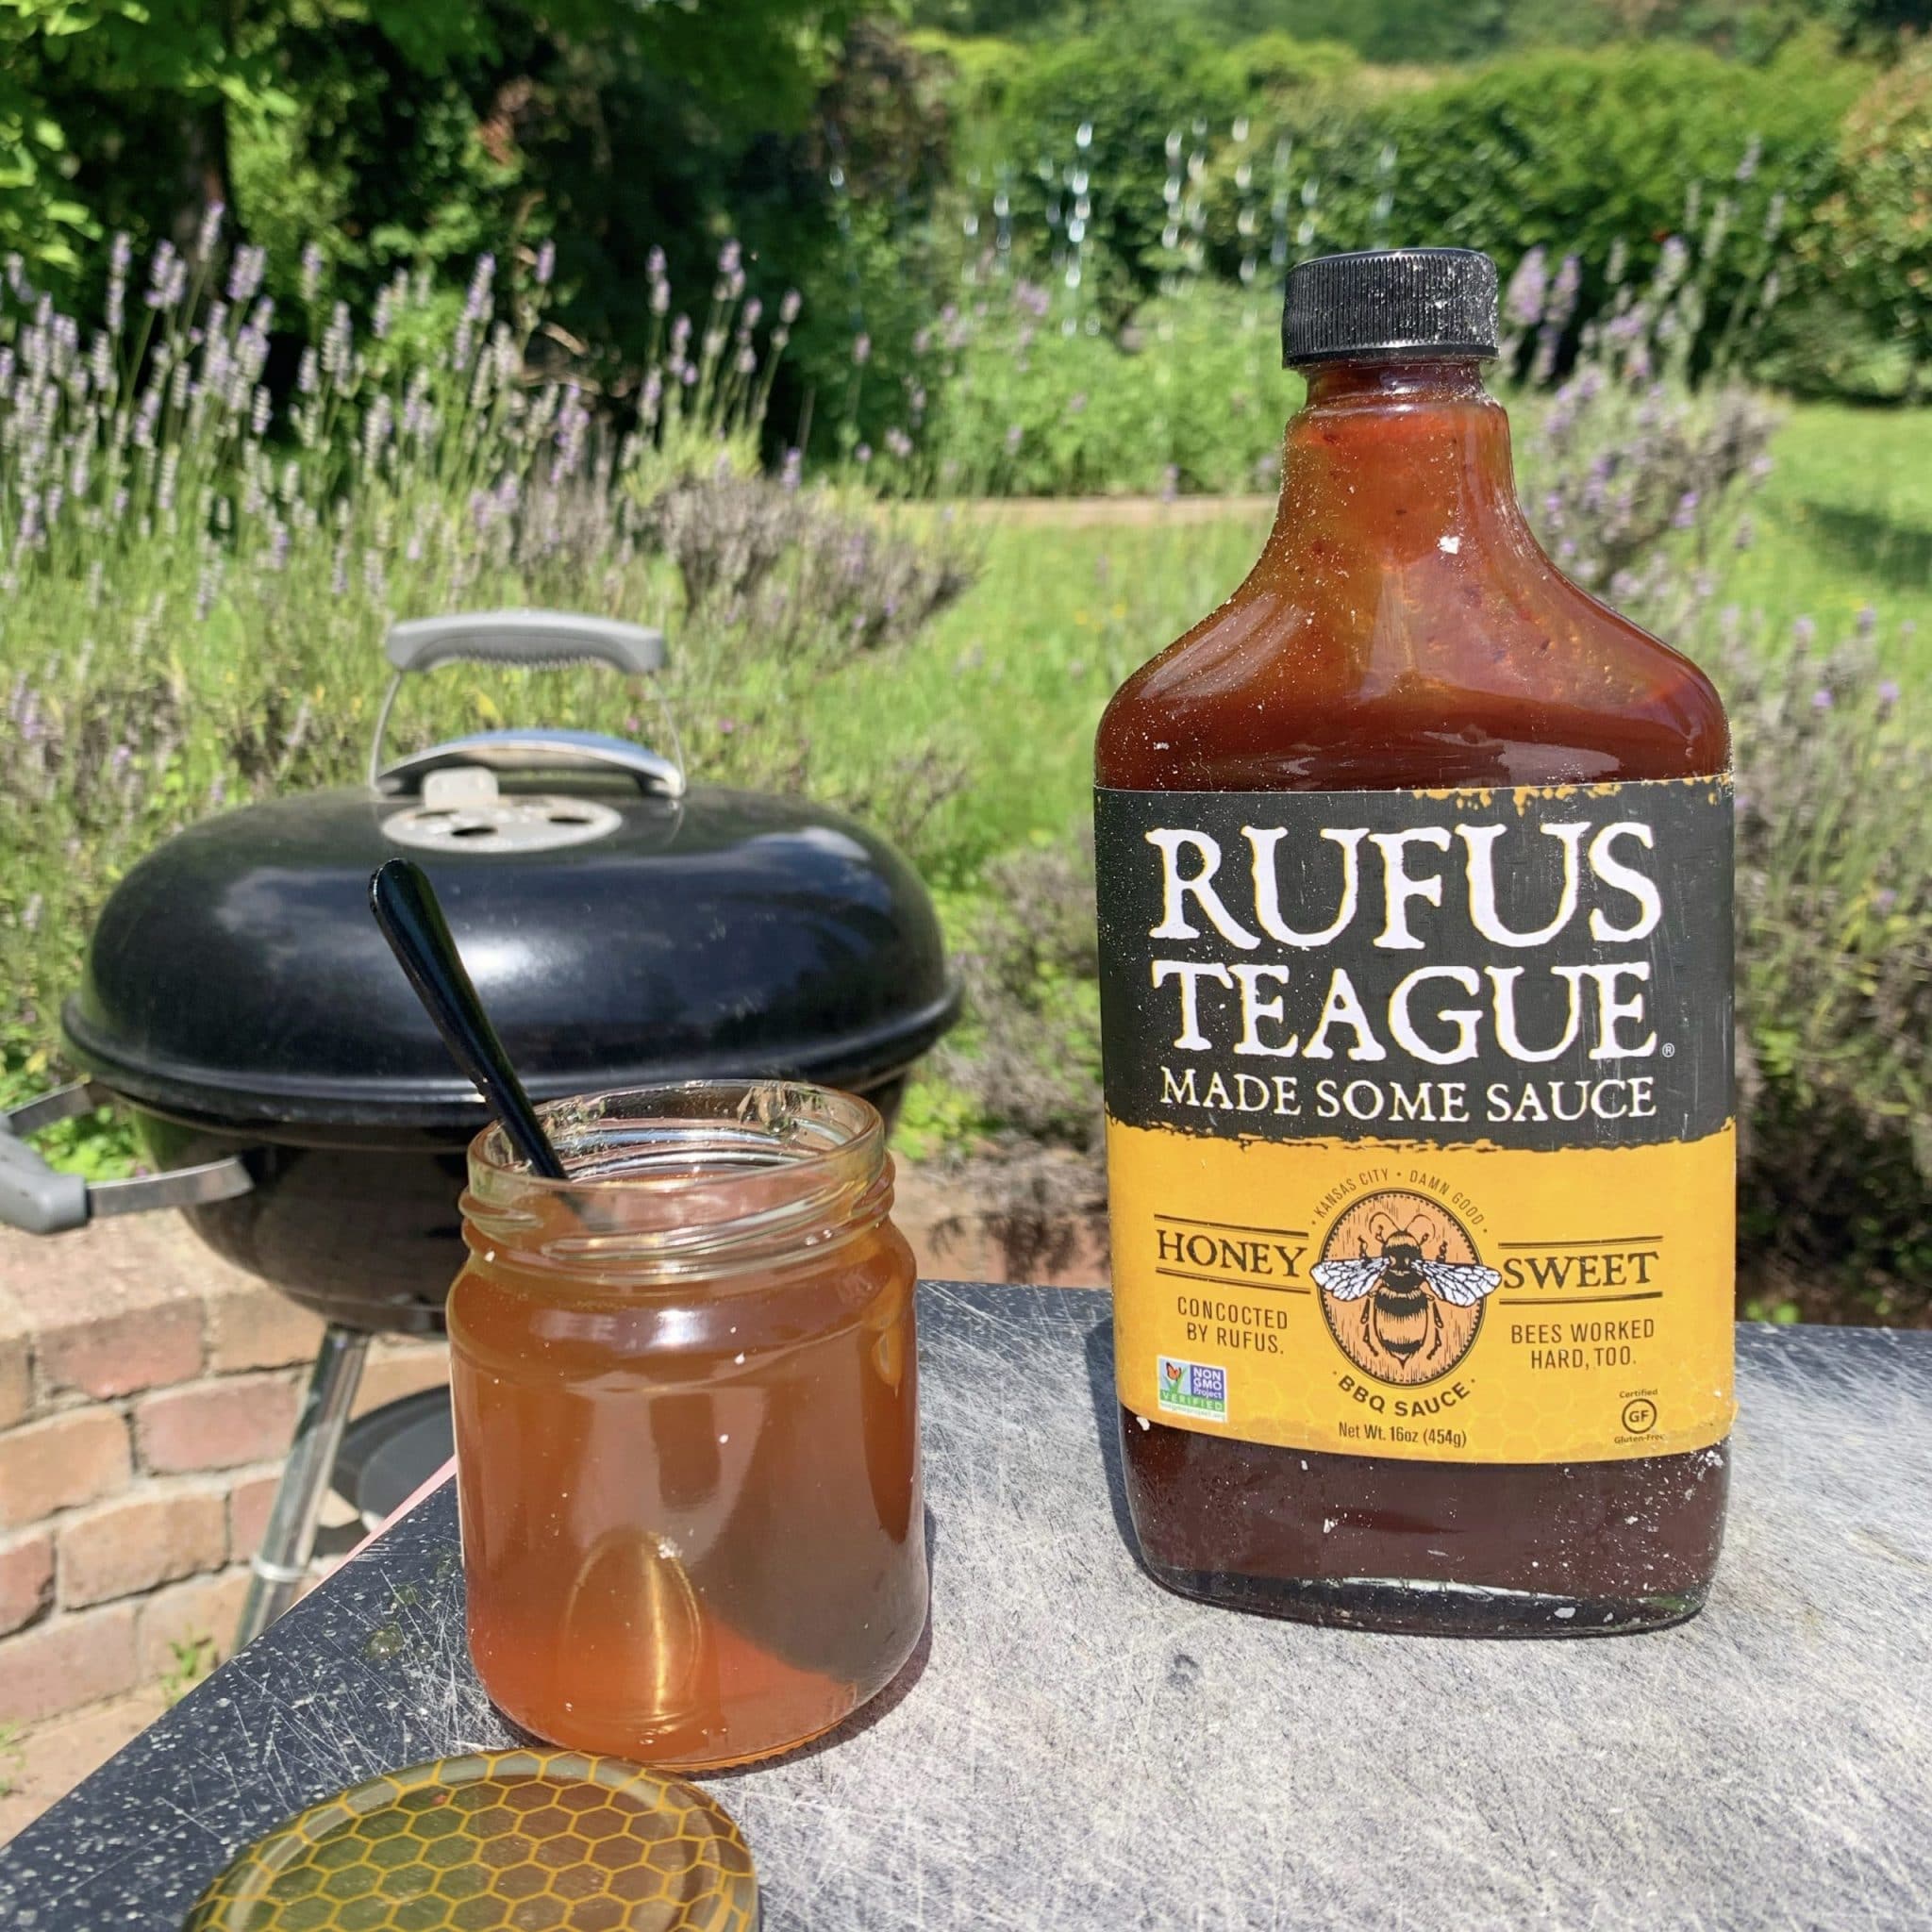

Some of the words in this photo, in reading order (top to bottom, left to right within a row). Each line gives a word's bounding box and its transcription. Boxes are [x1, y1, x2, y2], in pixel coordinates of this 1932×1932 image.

[1145, 822, 1661, 950] RUFUS
[1152, 960, 1657, 1064] TEAGUE
[1160, 1066, 1302, 1117] MADE
[1316, 1079, 1470, 1122] SOME
[1486, 1076, 1657, 1122] SAUCE
[1314, 1178, 1357, 1219] KANSAS
[1358, 1168, 1389, 1186] CITY
[1409, 1170, 1450, 1196] DAMN
[1452, 1191, 1485, 1225] GOOD
[1156, 1228, 1307, 1277] HONEY
[1503, 1251, 1659, 1290] SWEET
[1177, 1296, 1288, 1330] CONCOCTED
[1187, 1322, 1208, 1342] BY
[1217, 1328, 1284, 1355] RUFUS.
[1510, 1324, 1562, 1344] BEES
[1570, 1319, 1655, 1342] WORKED
[1531, 1350, 1590, 1371] HARD,
[1593, 1345, 1637, 1367] TOO.
[1192, 1367, 1222, 1381] NON
[1192, 1377, 1223, 1391] GMO
[1162, 1391, 1223, 1411] VERIFIED
[1192, 1387, 1223, 1399] Project
[1338, 1374, 1385, 1414] BBQ
[1394, 1382, 1471, 1417] SAUCE
[1619, 1388, 1658, 1398] Certified
[1628, 1409, 1649, 1423] GF
[1339, 1422, 1359, 1439] Net
[1364, 1424, 1386, 1441] Wt.
[1390, 1425, 1419, 1442] 16oz
[1423, 1427, 1467, 1449] (454g)
